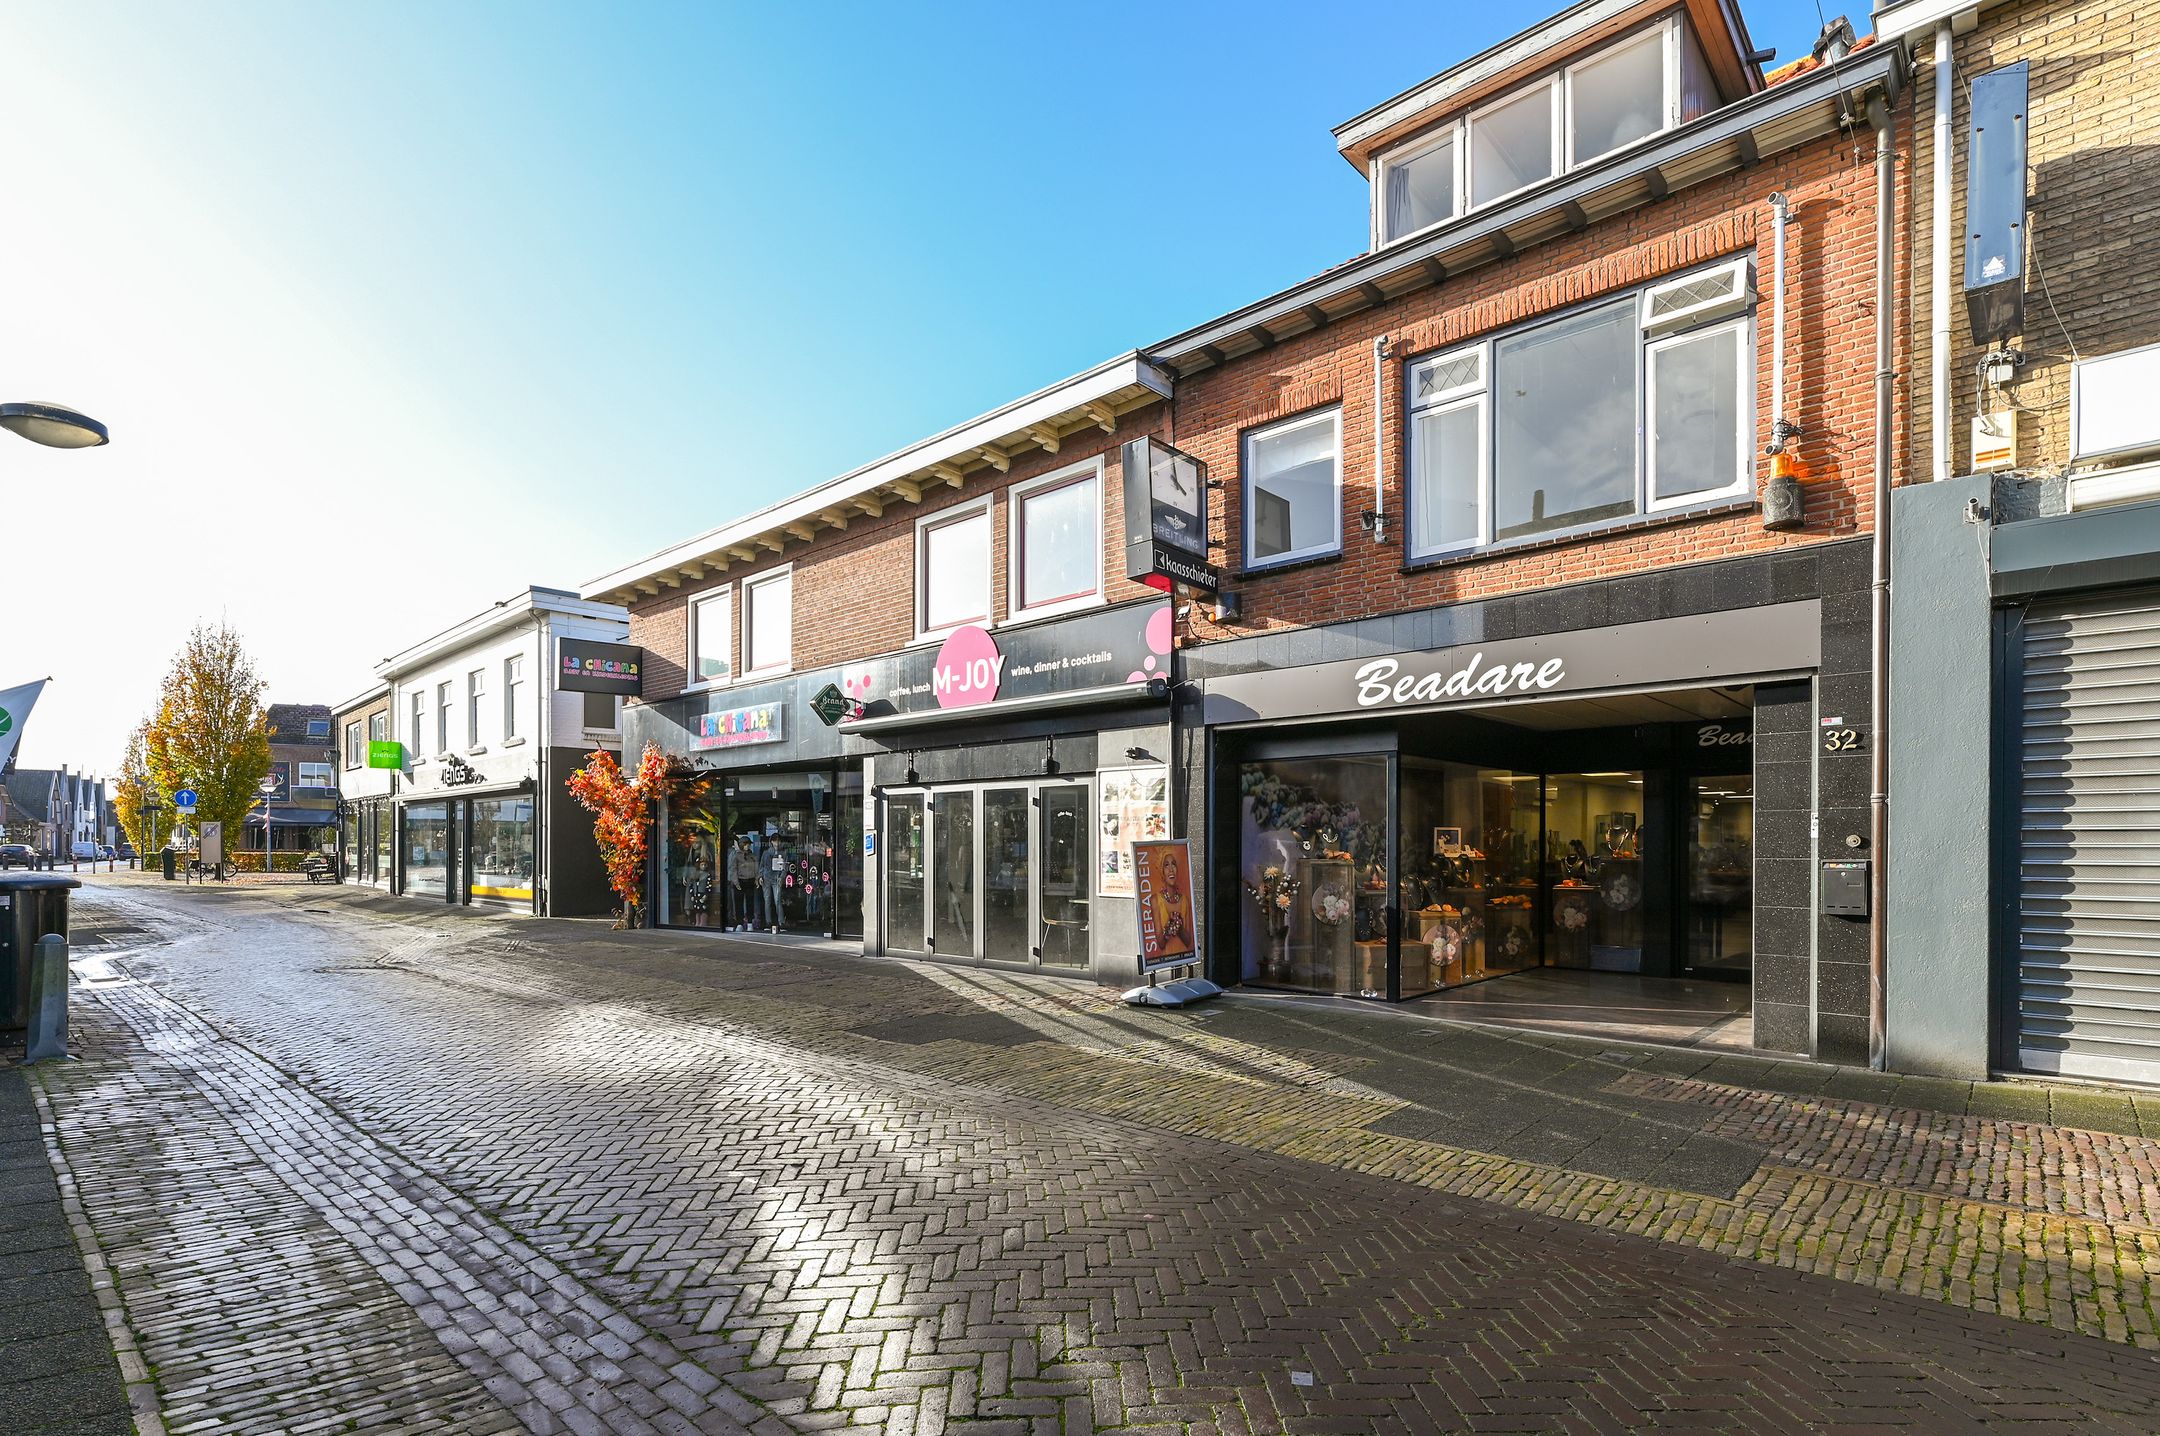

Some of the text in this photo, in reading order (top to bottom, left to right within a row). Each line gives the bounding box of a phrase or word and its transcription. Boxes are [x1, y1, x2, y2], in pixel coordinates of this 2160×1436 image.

[1153, 523, 1199, 549] BREITLING
[1166, 553, 1217, 588] kaasschieter
[932, 654, 1006, 696] M-JOY
[1011, 651, 1112, 677] wine, dinner & cocktails
[1354, 652, 1566, 706] Beadare
[912, 682, 931, 694] lunch
[1825, 729, 1857, 750] 32
[1137, 851, 1158, 953] SIERADEN
